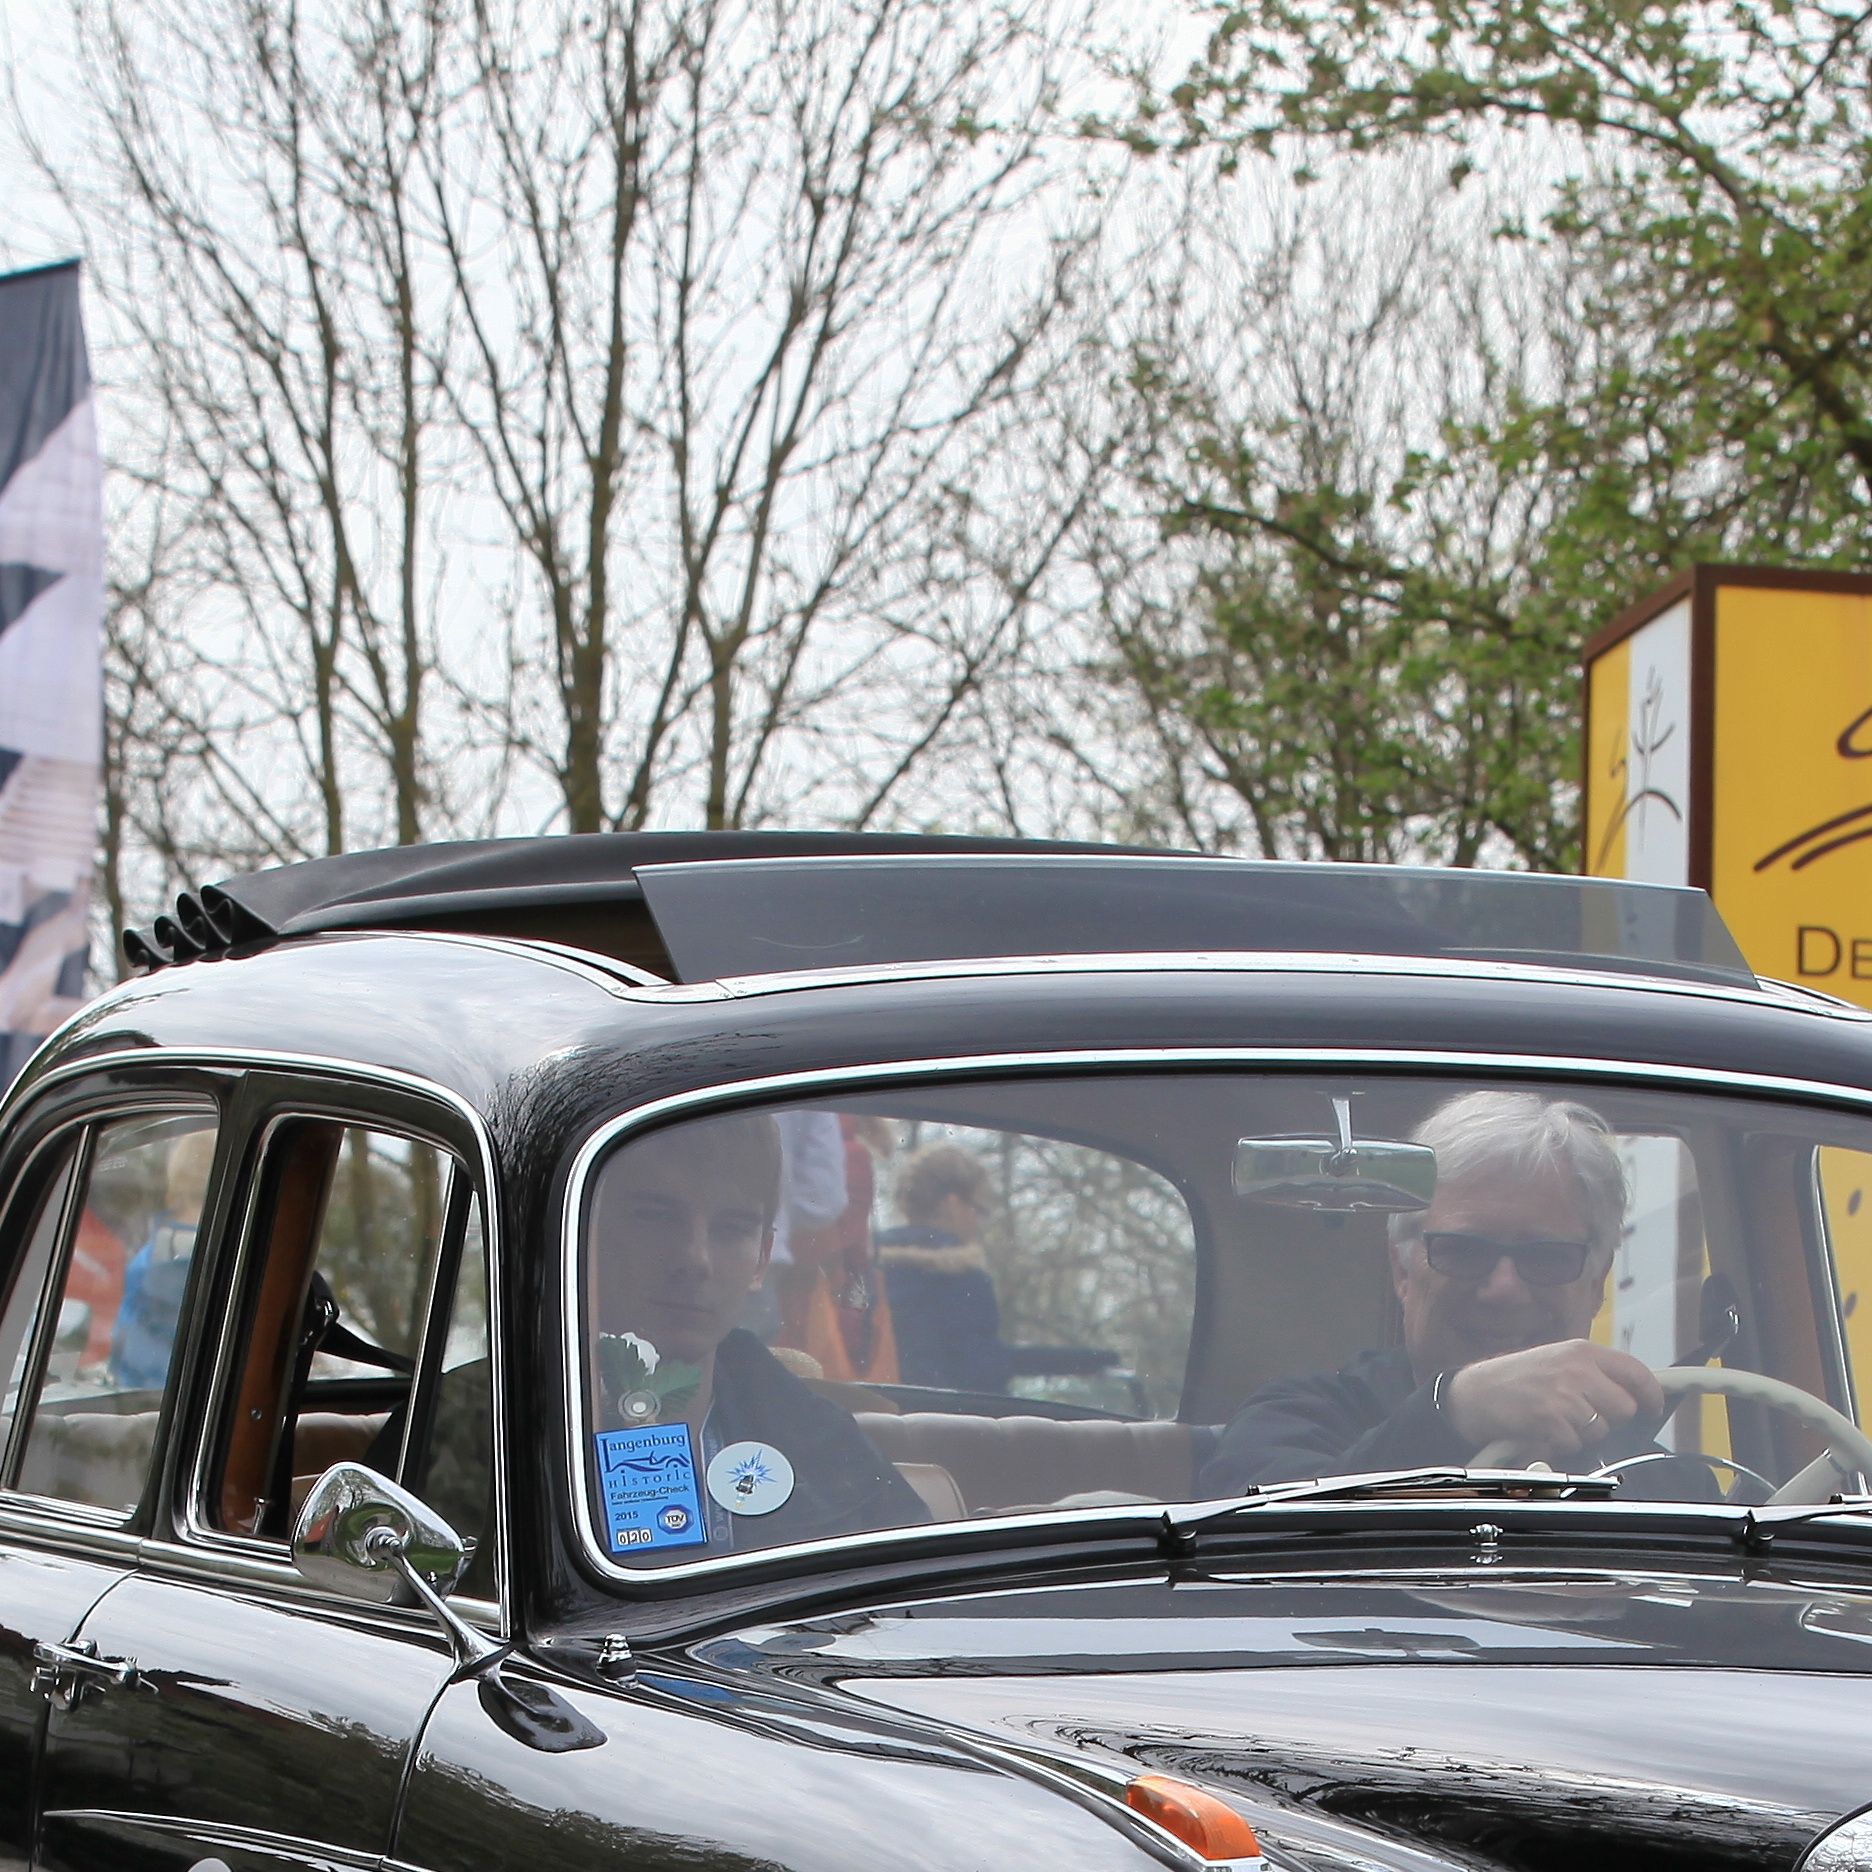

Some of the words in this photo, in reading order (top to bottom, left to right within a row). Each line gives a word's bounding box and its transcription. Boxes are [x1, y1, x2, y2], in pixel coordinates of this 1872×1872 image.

[599, 1434, 686, 1473] Langenburg
[611, 1484, 690, 1500] Fahrzeug-Check
[615, 1511, 639, 1521] 2015
[618, 1529, 652, 1545] 020
